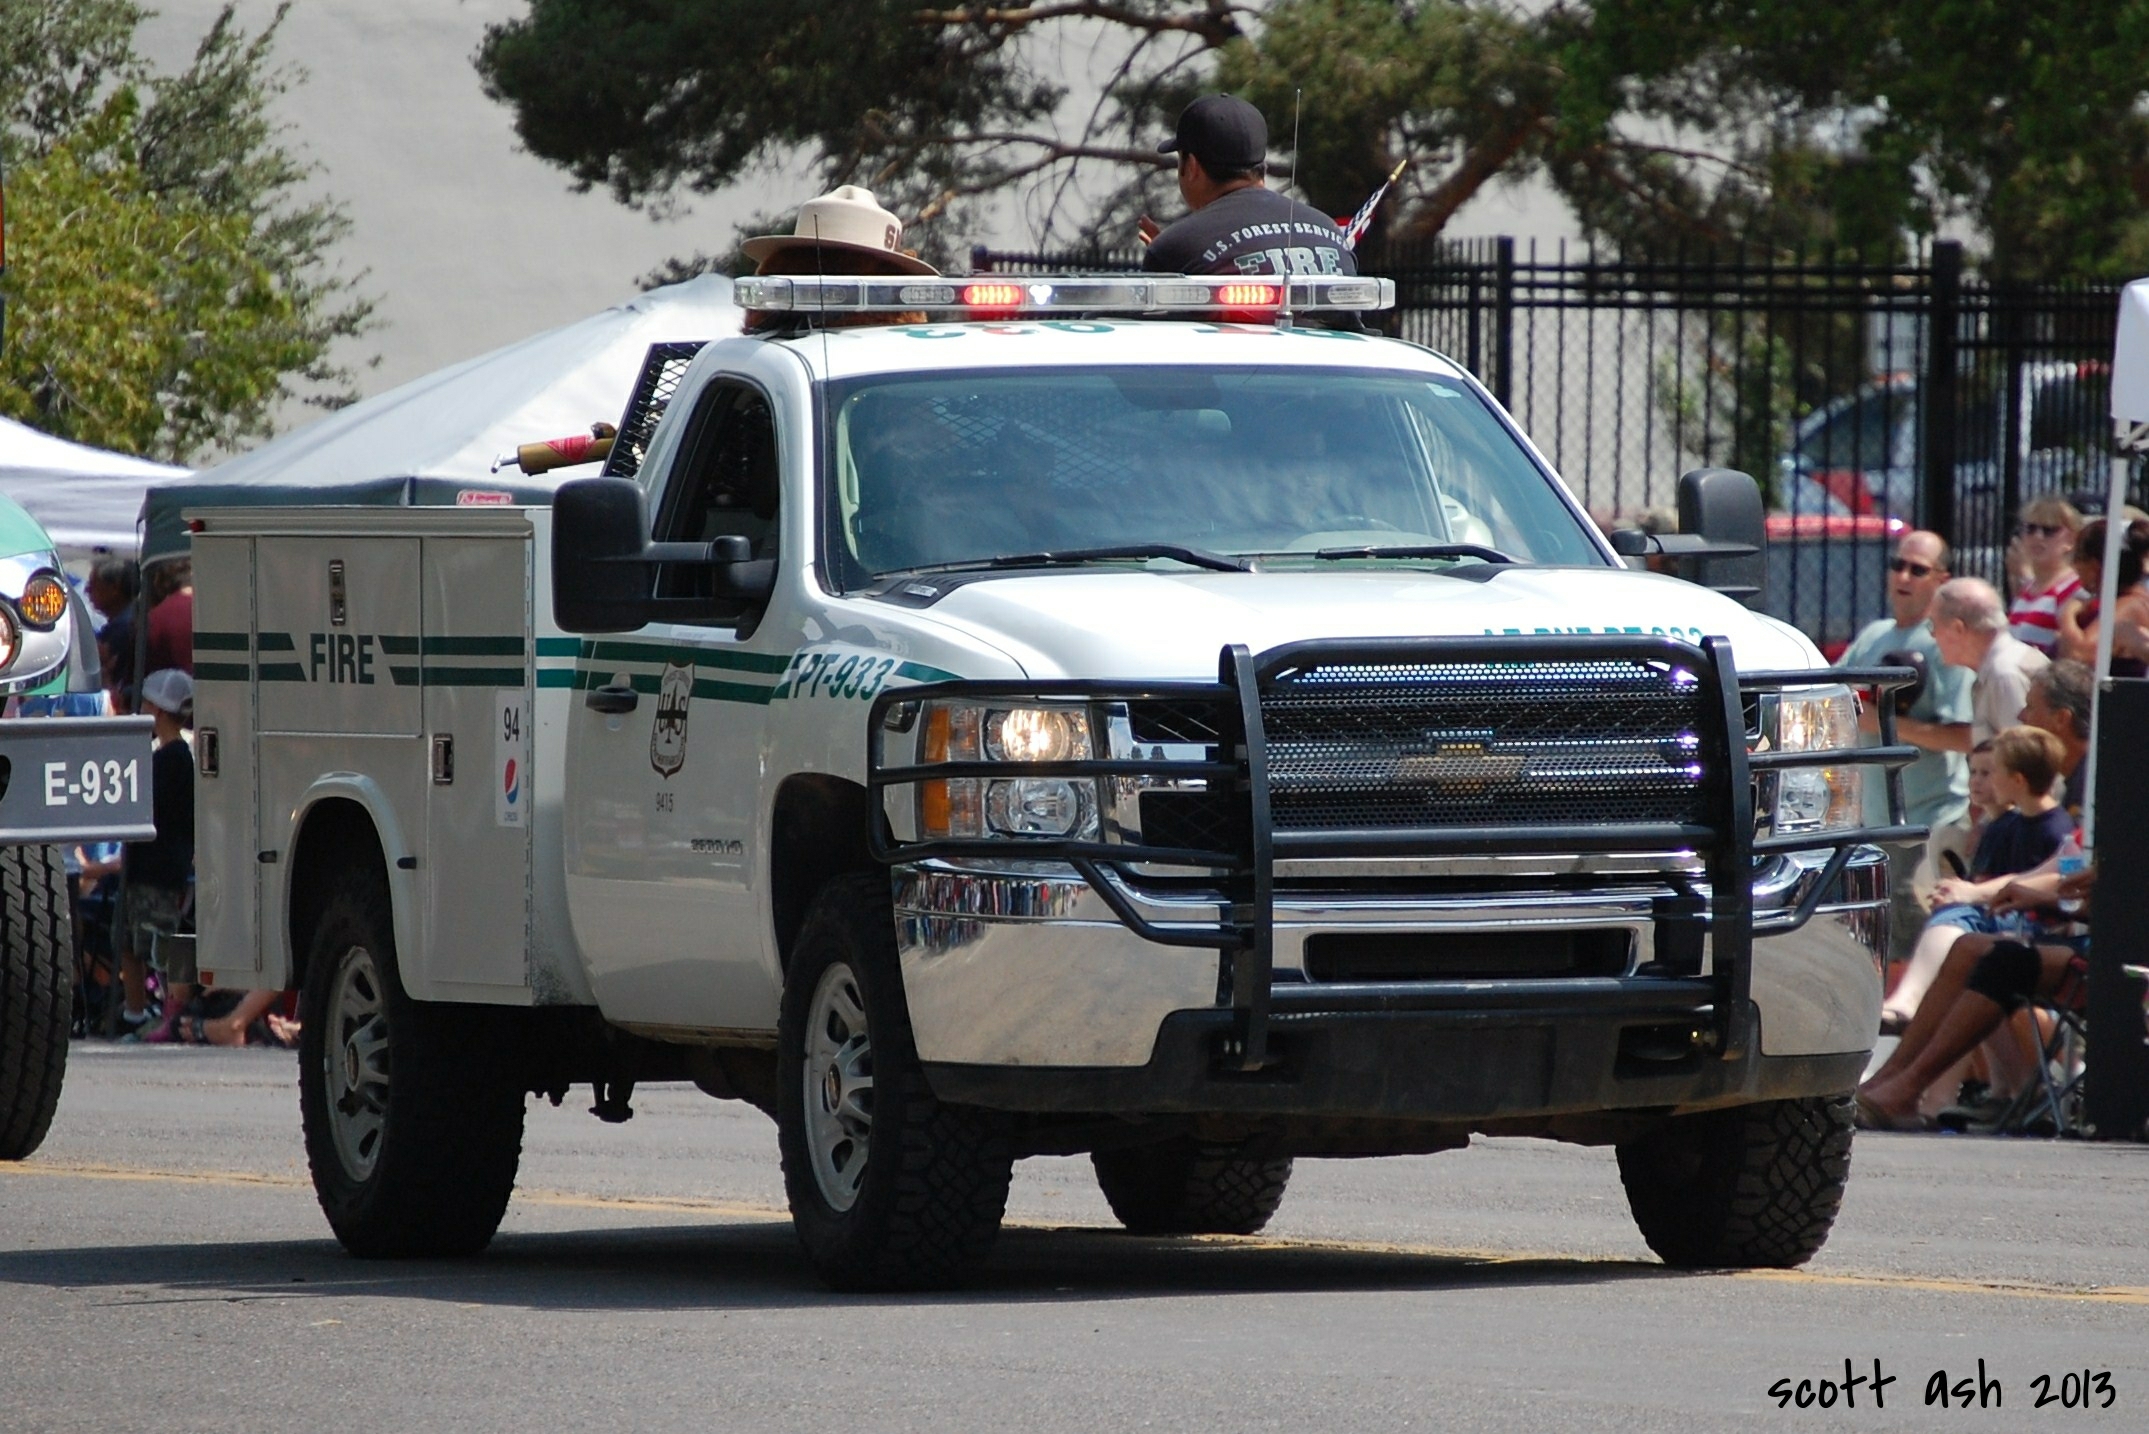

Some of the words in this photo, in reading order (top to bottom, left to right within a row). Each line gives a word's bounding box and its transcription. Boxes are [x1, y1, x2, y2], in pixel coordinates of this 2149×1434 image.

[1202, 239, 1233, 262] U.S.
[1231, 222, 1291, 244] FOREST
[1233, 247, 1343, 276] FIRE
[310, 632, 375, 685] FIRE
[792, 653, 895, 701] PT-933
[503, 706, 520, 742] 94
[44, 758, 138, 806] E-931
[656, 792, 674, 813] 9415
